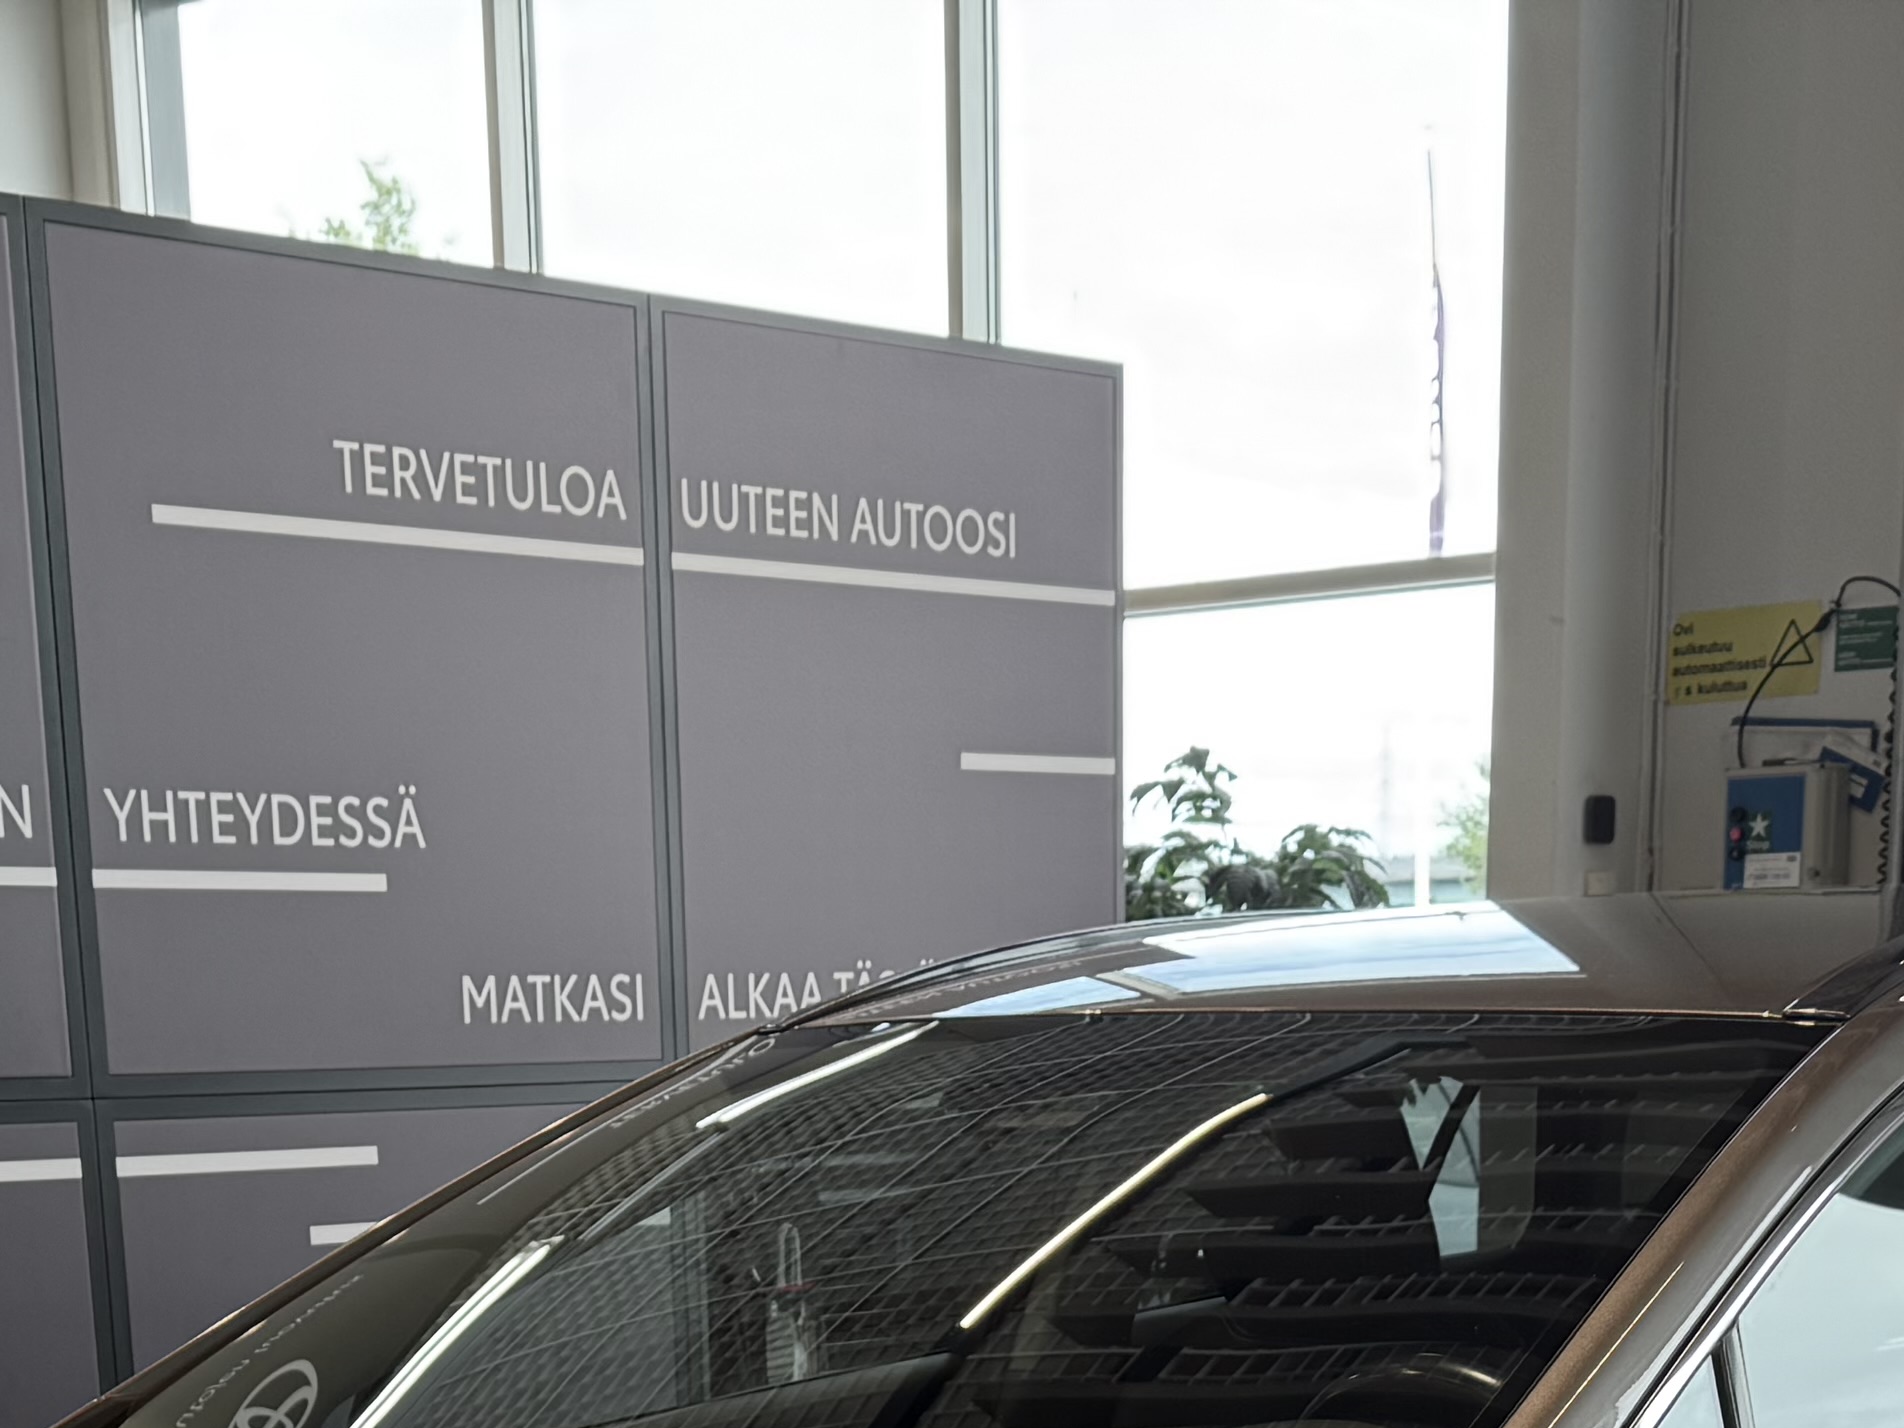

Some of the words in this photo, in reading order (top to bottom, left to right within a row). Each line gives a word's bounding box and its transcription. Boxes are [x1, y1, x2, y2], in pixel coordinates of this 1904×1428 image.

[332, 438, 628, 521] TERVETULOA
[680, 476, 839, 542] UUTEEN
[850, 496, 1017, 559] AUTOOSI
[1673, 623, 1694, 637] Ovi
[102, 783, 428, 850] YHTEYDESSÄ
[461, 971, 645, 1025] MATKASI
[697, 971, 823, 1021] ALKAA
